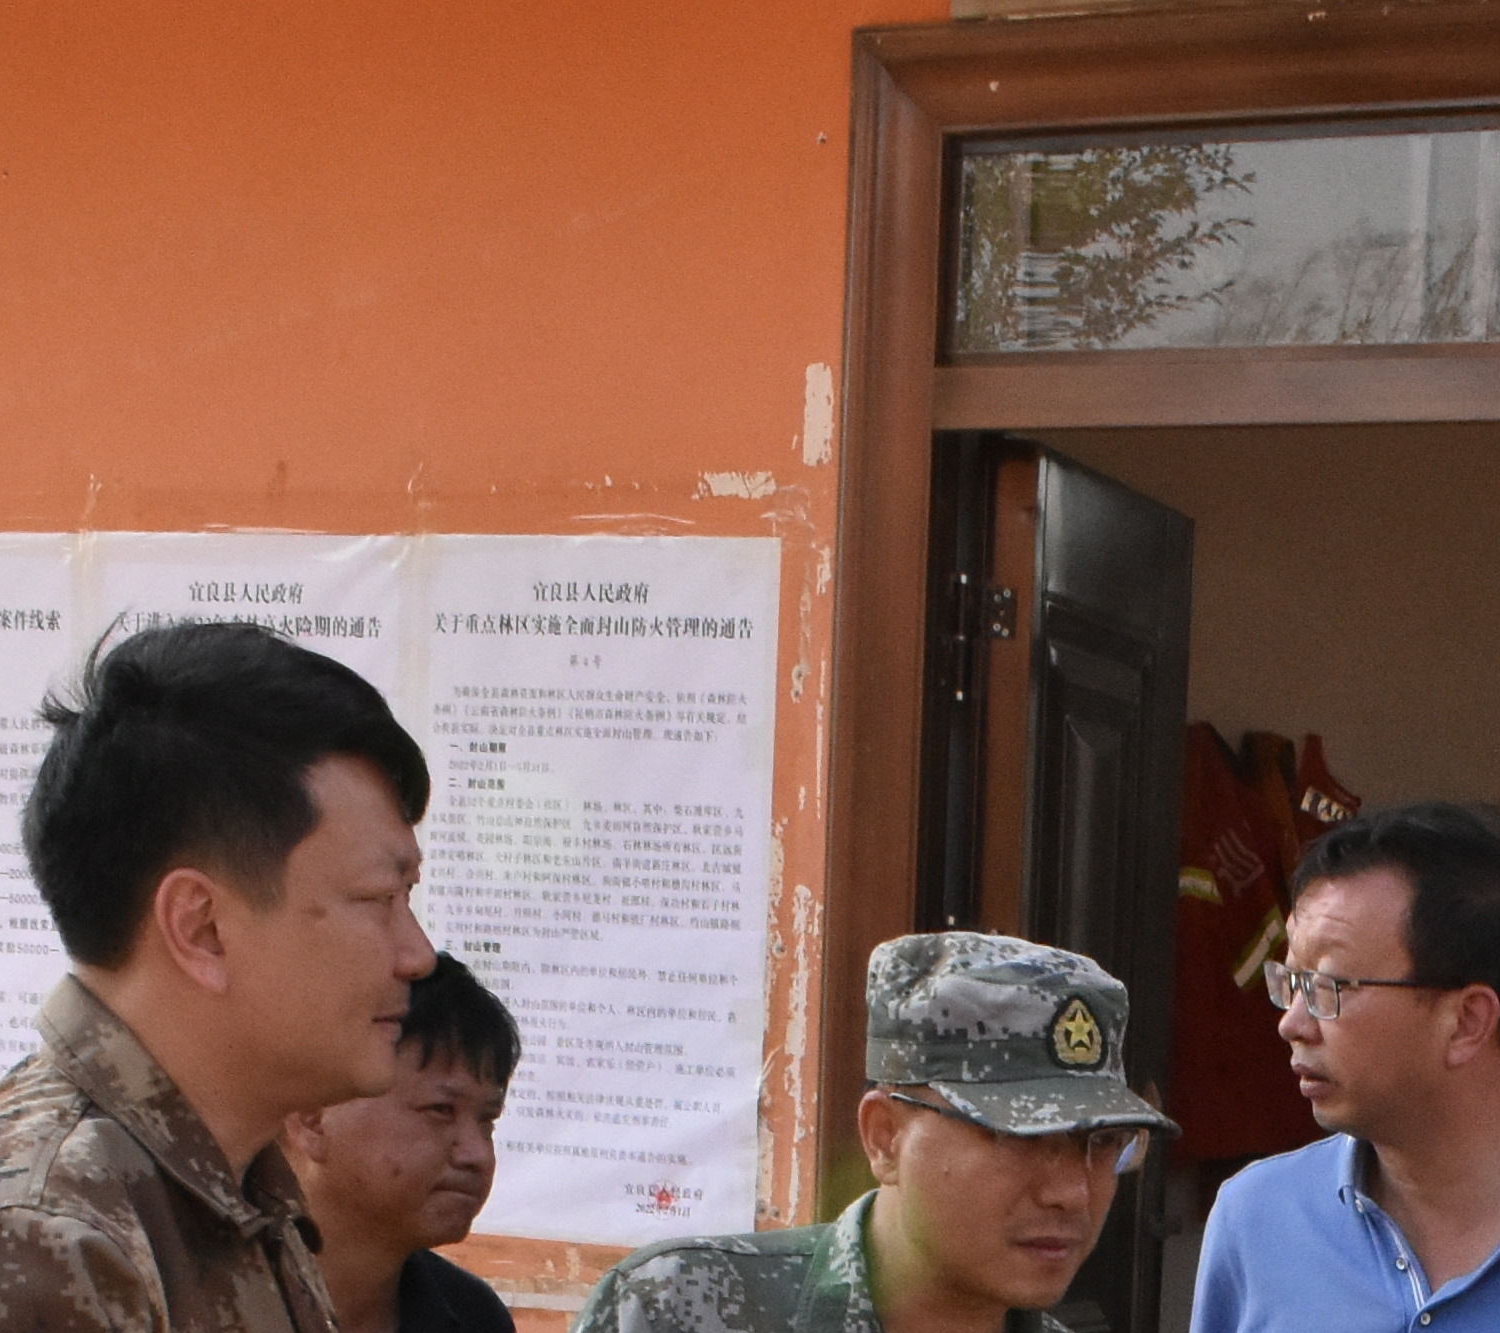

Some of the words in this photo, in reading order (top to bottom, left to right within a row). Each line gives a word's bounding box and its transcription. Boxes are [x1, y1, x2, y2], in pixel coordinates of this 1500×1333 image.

[189, 581, 304, 605] 宜良县人民政府
[533, 581, 649, 604] 宜良县人民政府
[434, 613, 754, 639] 关于重点林区实施全面封山防火管理的通告
